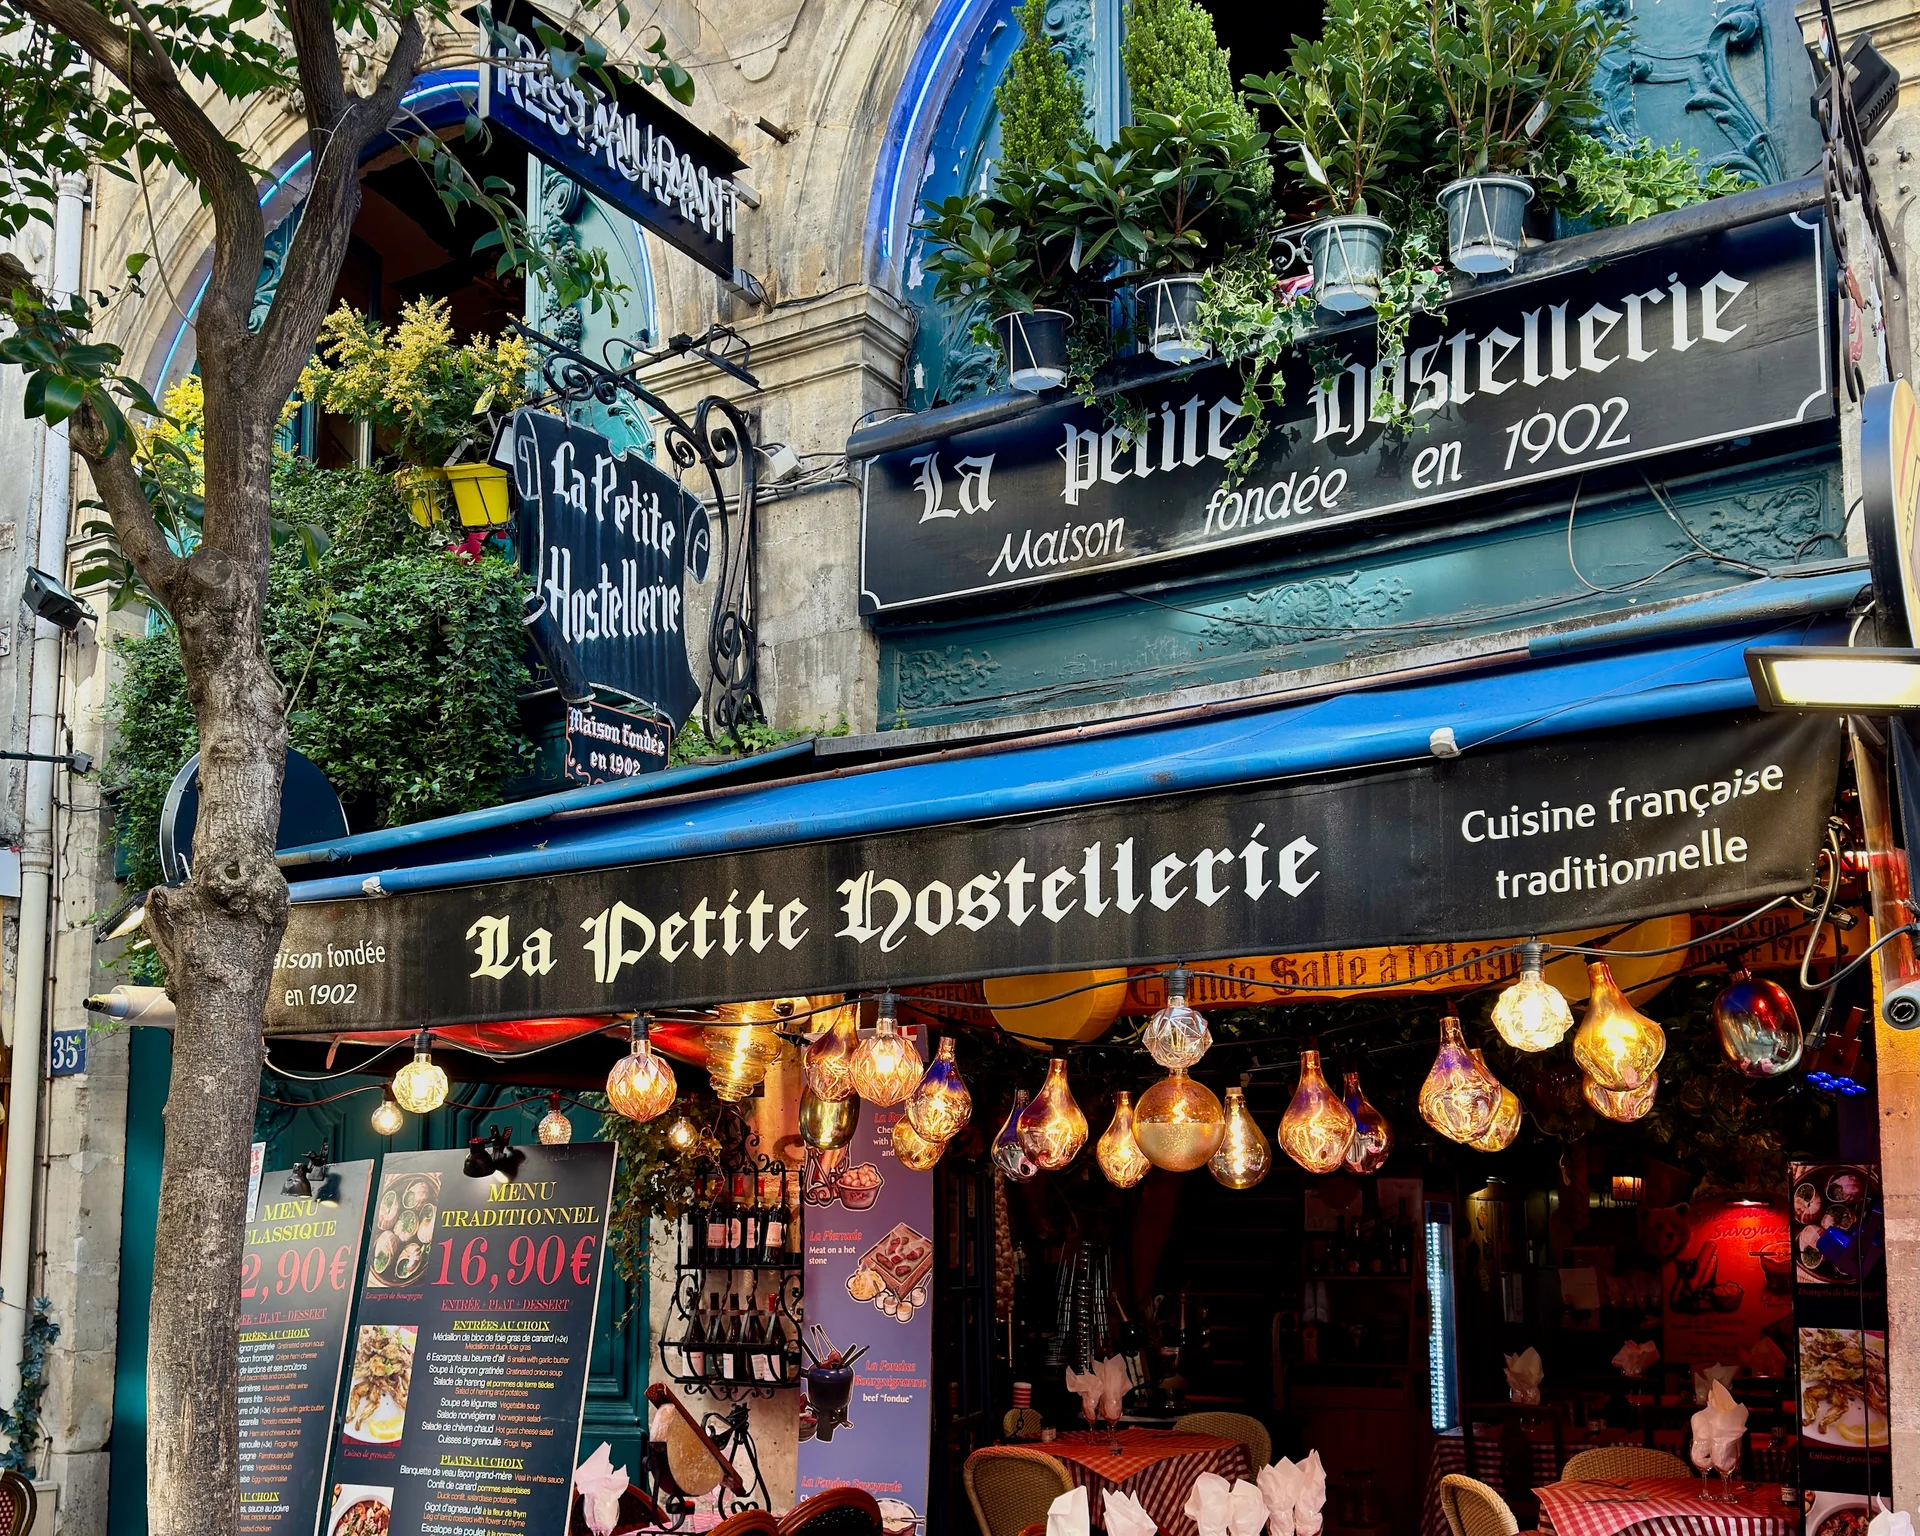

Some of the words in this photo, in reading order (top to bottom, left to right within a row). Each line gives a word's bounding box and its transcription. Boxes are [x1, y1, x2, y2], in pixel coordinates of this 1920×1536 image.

[909, 451, 997, 525] La
[987, 516, 1125, 577] Maison
[1203, 464, 1349, 537] fondée
[1411, 440, 1463, 490] en
[1504, 396, 1632, 472] 1902
[551, 441, 588, 515] La
[591, 453, 676, 559] Petite
[544, 545, 681, 645] Hostellerie
[568, 706, 621, 744] Maison
[589, 750, 607, 771] en
[609, 752, 641, 777] 1902
[1461, 799, 1597, 843] Cuisine
[1608, 764, 1784, 824] française
[1495, 827, 1749, 900] traditionnelle
[465, 914, 558, 979] La
[580, 888, 810, 984] Petite
[834, 822, 1321, 953] Hostellerie
[271, 945, 323, 971] aison
[326, 940, 386, 968] fondée
[1271, 951, 1368, 996] Salle
[284, 986, 304, 1007] en
[308, 982, 358, 1006] 1902
[52, 1035, 79, 1069] 35
[873, 1137, 889, 1146] with
[881, 1149, 895, 1157] and
[487, 1181, 557, 1202] MENU
[261, 1198, 320, 1222] MENU
[441, 1206, 600, 1228] TRADITIONNEL
[808, 1230, 821, 1242] La
[808, 1246, 827, 1254] Meat
[843, 1246, 856, 1254] hot
[808, 1257, 828, 1265] stone
[241, 1244, 352, 1305] 2,90€
[441, 1297, 481, 1311] ENTRÉE
[488, 1299, 515, 1311] PLAT
[522, 1299, 570, 1311] DESSERT
[260, 1311, 282, 1323] PLAT
[287, 1307, 328, 1321] DESSERT
[453, 1319, 499, 1331] ENTRÉES
[500, 1321, 515, 1331] AU
[516, 1321, 550, 1332] CHOIX
[282, 1328, 311, 1340] CHOIX
[461, 1333, 470, 1342] de
[485, 1334, 494, 1342] de
[507, 1335, 521, 1345] gras
[522, 1334, 530, 1343] de
[531, 1334, 555, 1343] canard
[426, 1353, 431, 1361] 6
[471, 1354, 491, 1363] beurre
[428, 1364, 449, 1375] Soupe
[864, 1360, 878, 1372] La
[433, 1376, 454, 1386] Salade
[454, 1378, 463, 1387] de
[440, 1397, 460, 1408] Soupe
[461, 1399, 470, 1407] de
[470, 1399, 497, 1410] légumes
[862, 1393, 879, 1402] beef
[436, 1409, 457, 1419] Salade
[421, 1421, 442, 1431] Salade
[442, 1422, 452, 1431] de
[474, 1424, 494, 1433] chaud
[437, 1434, 462, 1444] Cuisses
[462, 1435, 471, 1445] de
[440, 1454, 473, 1466] PLATS
[473, 1456, 489, 1467] AU
[490, 1458, 524, 1469] CHOIX
[432, 1467, 441, 1476] de
[441, 1469, 456, 1477] veau
[445, 1481, 454, 1490] de
[455, 1482, 477, 1491] canard
[251, 1492, 280, 1502] CHOIX
[453, 1525, 462, 1534] de
